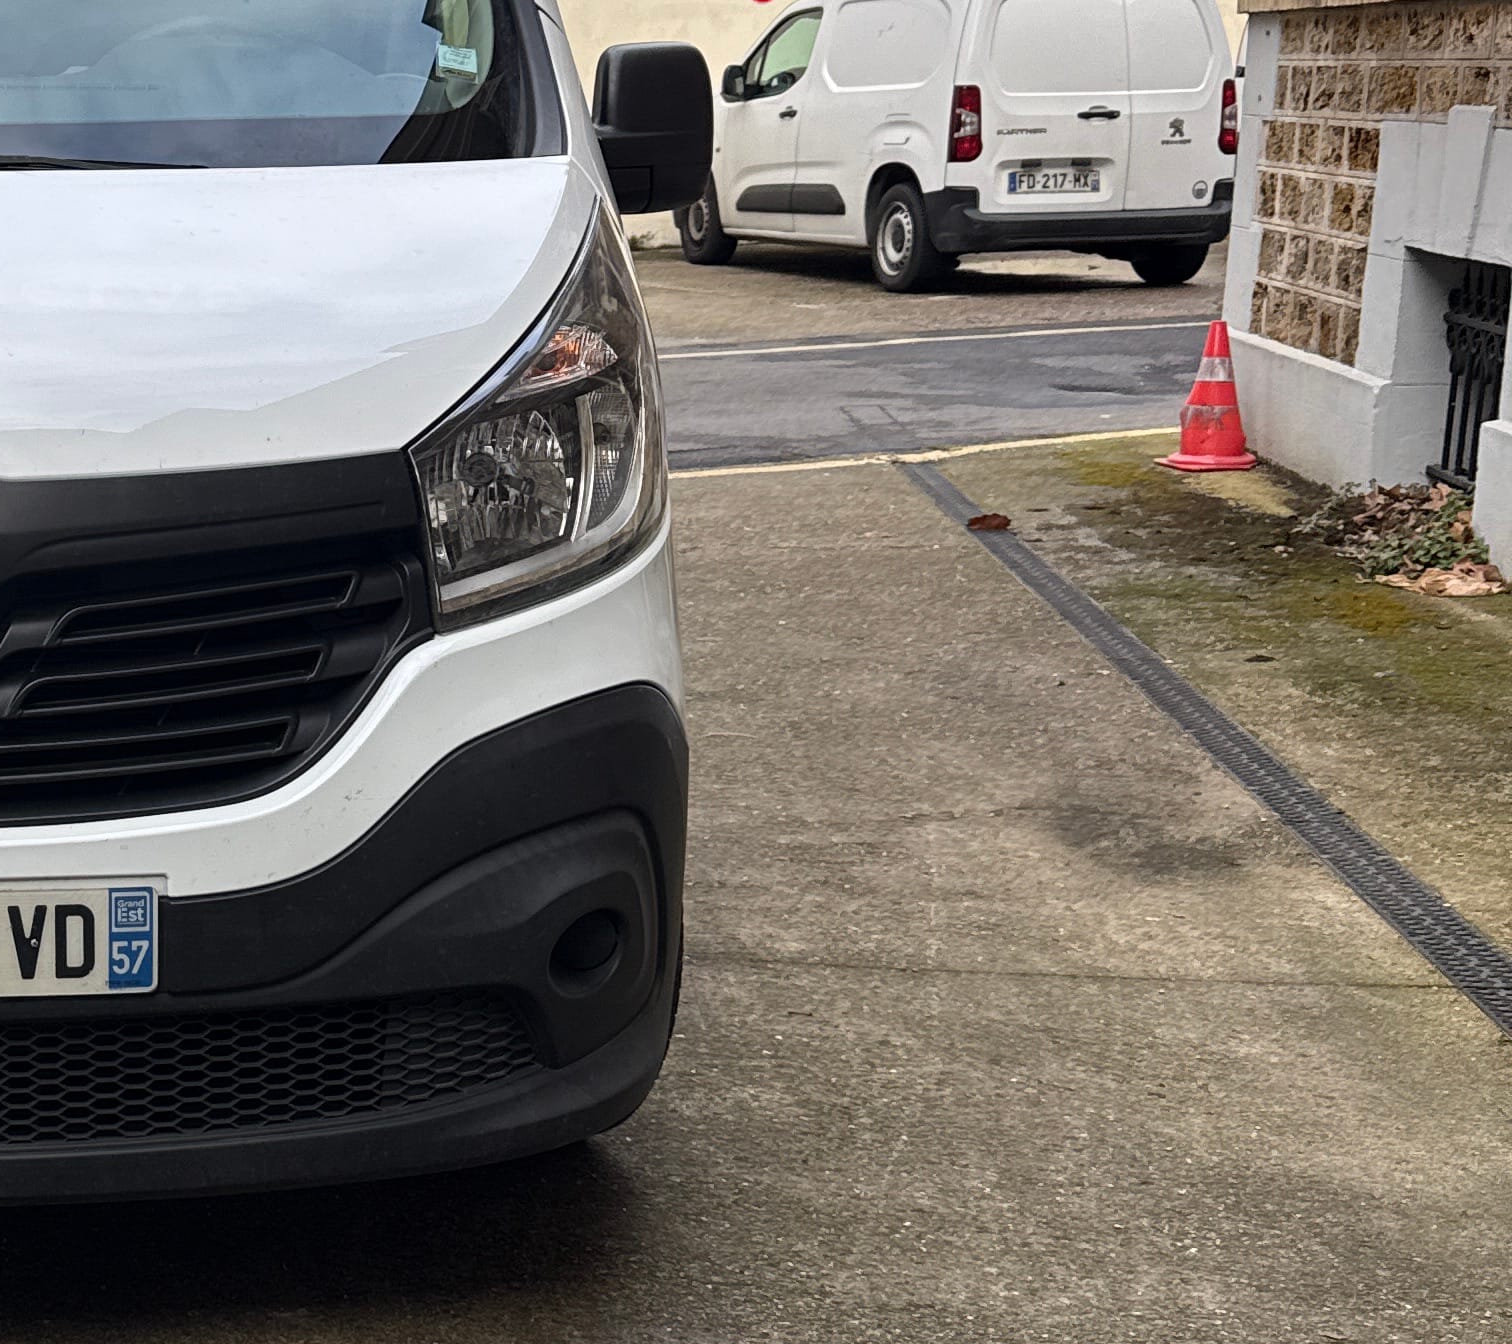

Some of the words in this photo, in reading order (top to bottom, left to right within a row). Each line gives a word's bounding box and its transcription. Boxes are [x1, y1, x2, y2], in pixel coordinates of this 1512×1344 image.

[117, 899, 145, 908] Grand
[117, 907, 145, 922] Est
[111, 939, 150, 975] 57
